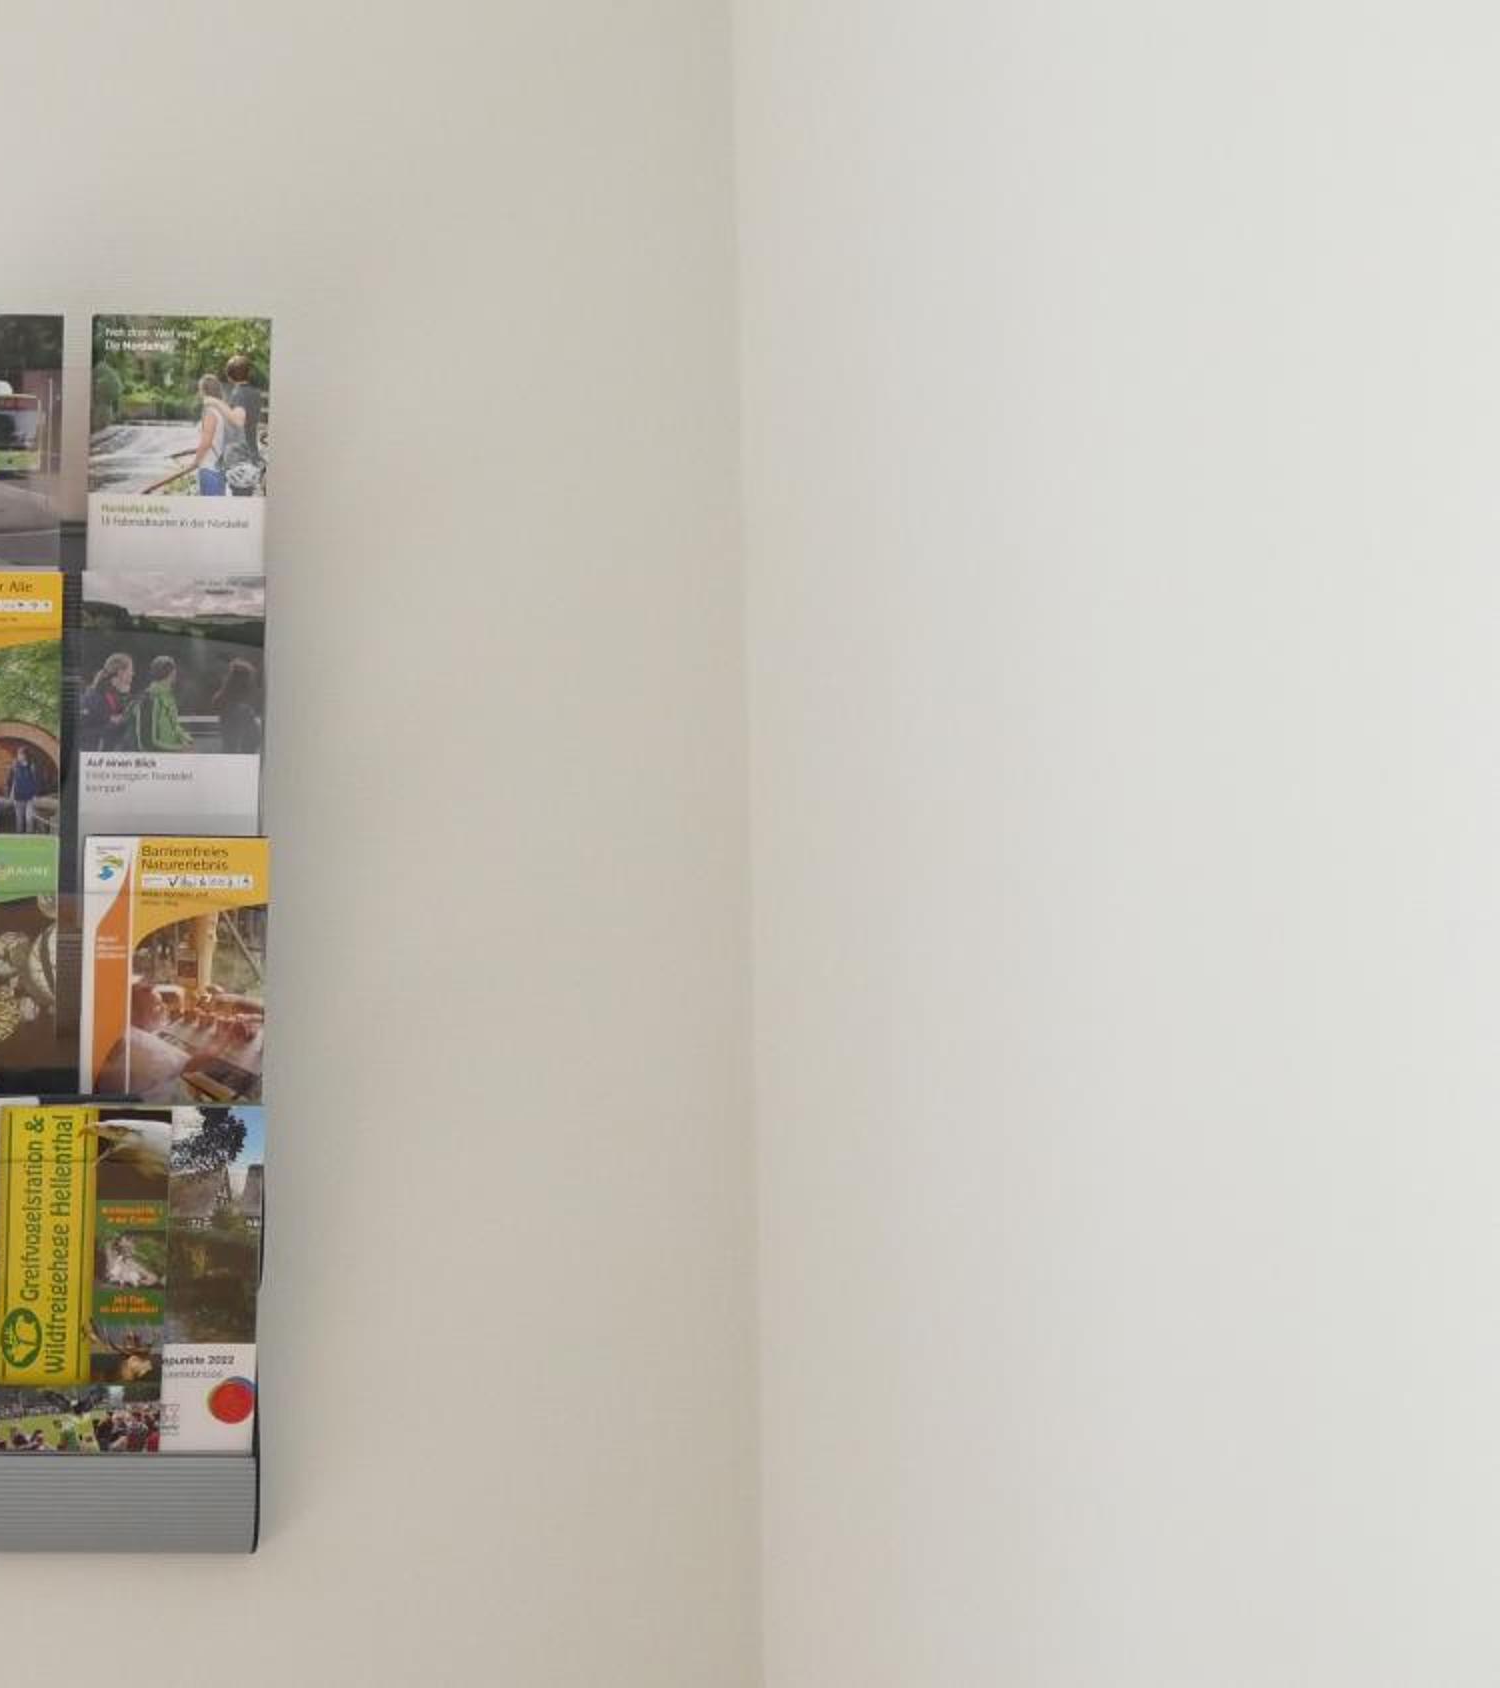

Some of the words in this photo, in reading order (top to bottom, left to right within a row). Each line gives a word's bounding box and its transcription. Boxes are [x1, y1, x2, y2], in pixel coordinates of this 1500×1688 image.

[9, 580, 35, 593] Alle
[141, 845, 229, 857] Barrierefreies
[141, 858, 229, 871] Naturerlebnis
[24, 1114, 45, 1133] &
[49, 1114, 74, 1217] Hellenthal
[19, 1140, 43, 1302] Greifvogelstation
[43, 1221, 70, 1375] Wildfreigehege
[206, 1355, 235, 1365] 2022
